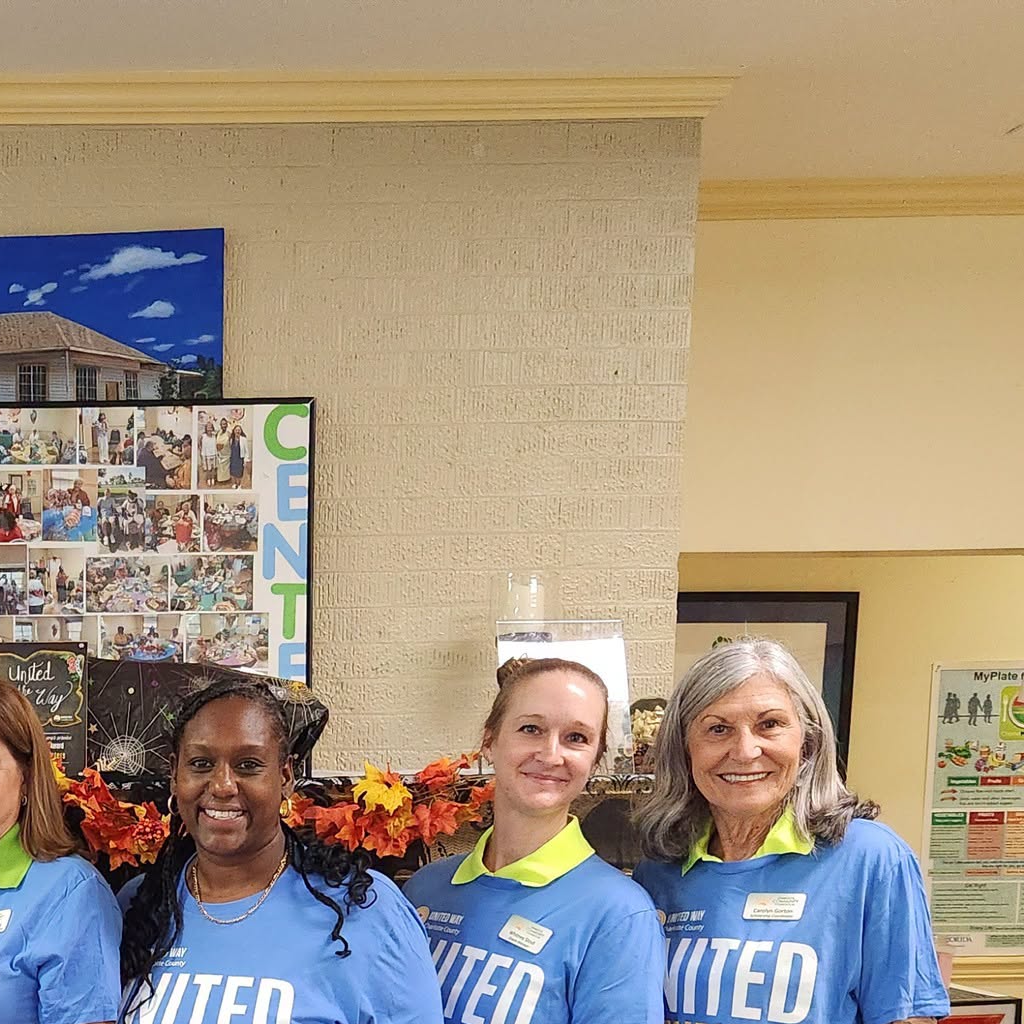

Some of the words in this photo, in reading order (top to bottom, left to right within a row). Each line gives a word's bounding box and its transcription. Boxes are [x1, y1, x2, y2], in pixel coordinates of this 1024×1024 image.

[8, 660, 56, 685] United
[973, 671, 1019, 683] MyPlate
[35, 680, 73, 713] Way
[428, 911, 451, 923] UNITED
[449, 913, 465, 925] WAY
[689, 910, 706, 921] WAY
[684, 924, 705, 932] County
[169, 947, 187, 958] WAY
